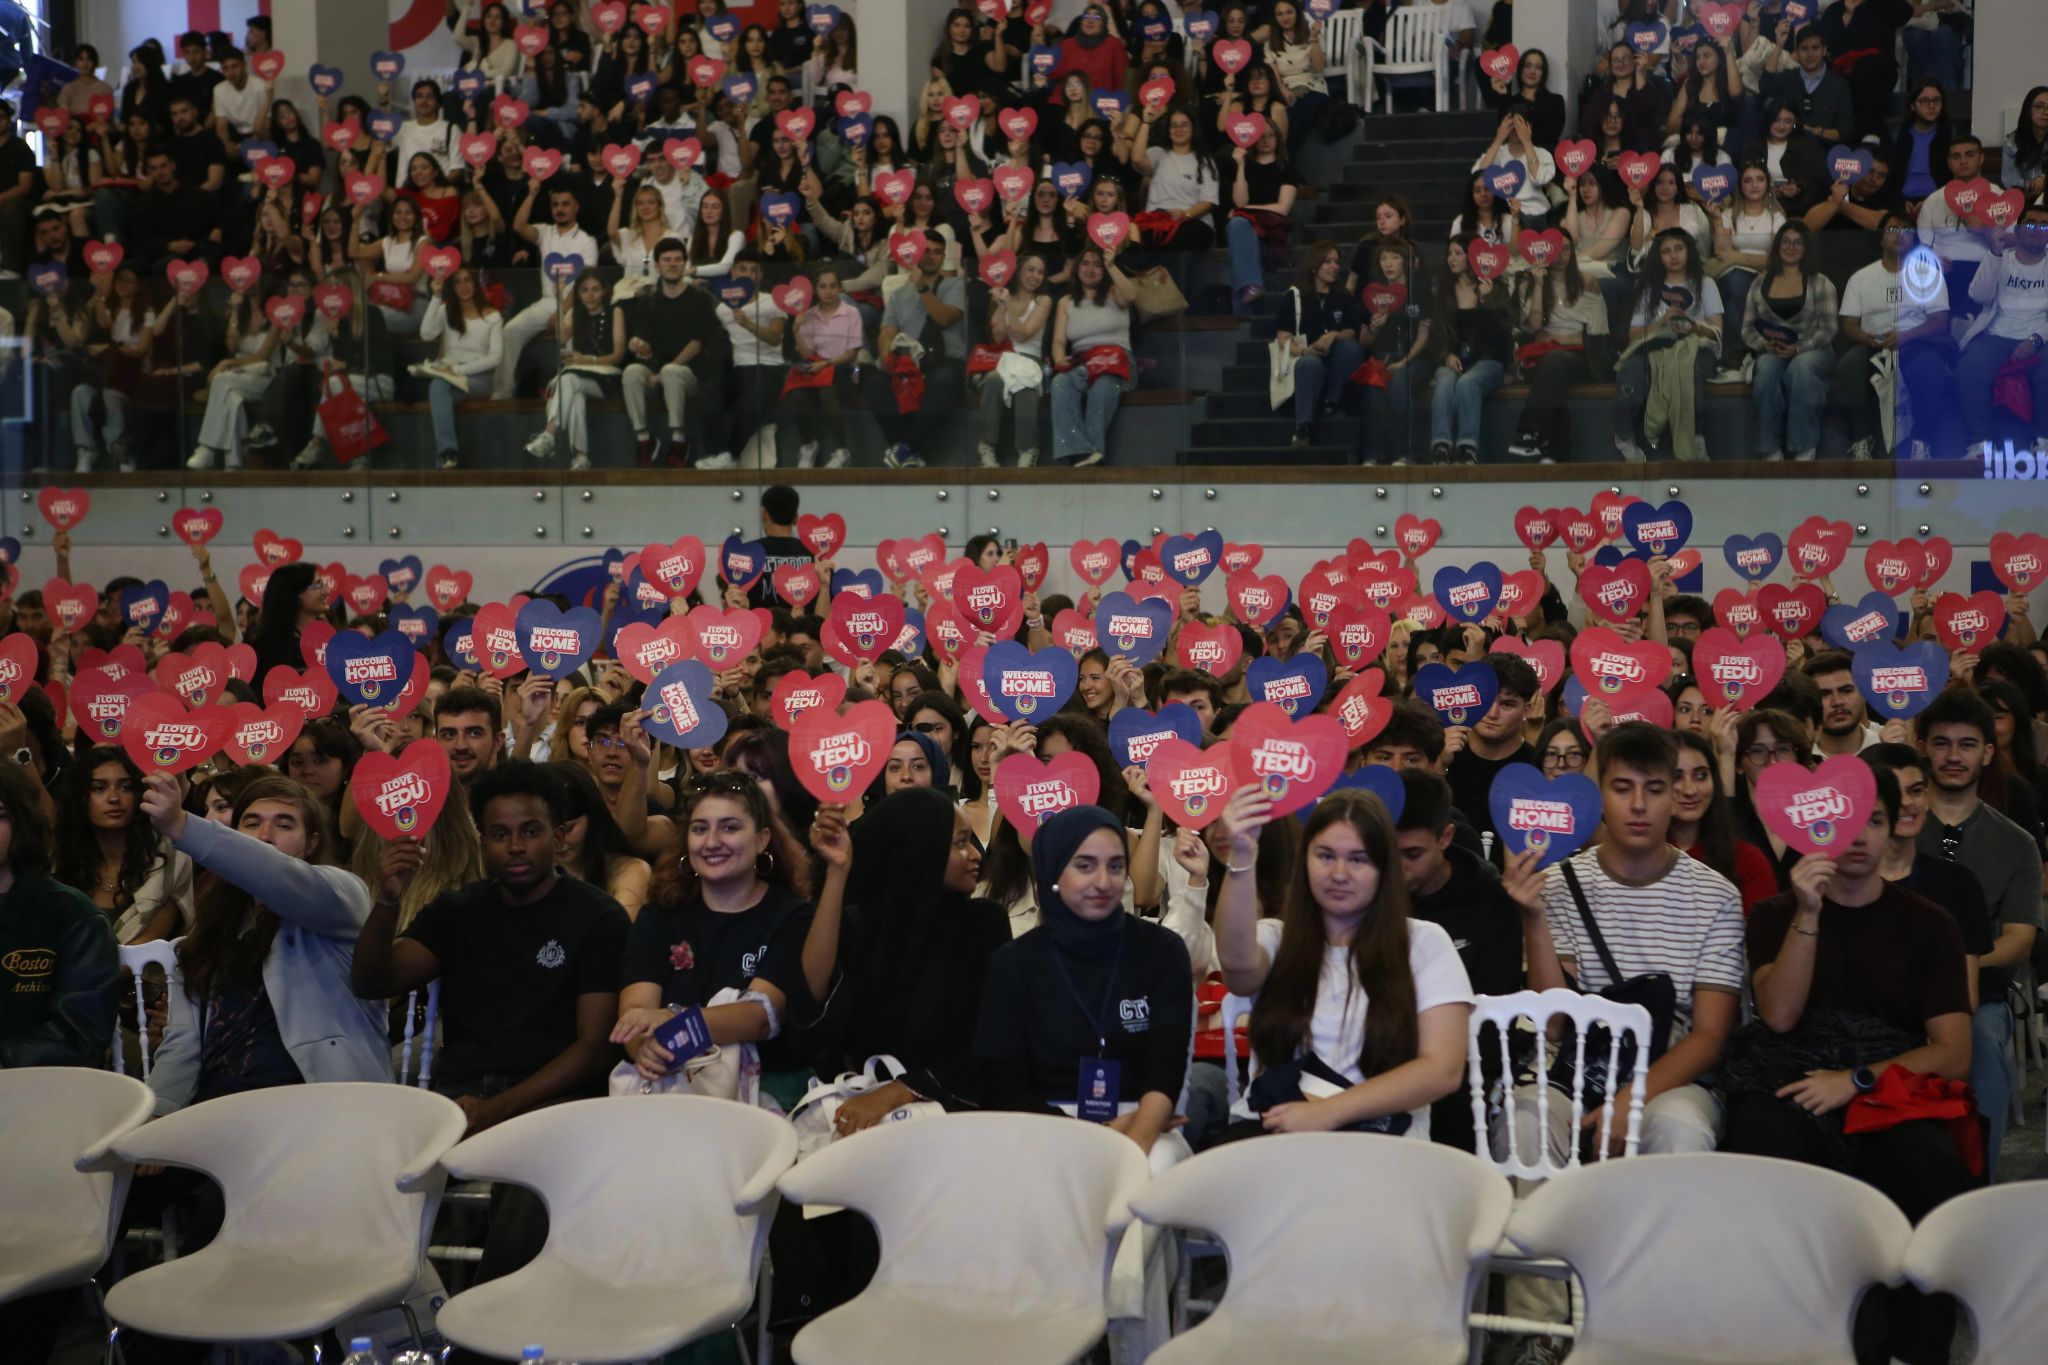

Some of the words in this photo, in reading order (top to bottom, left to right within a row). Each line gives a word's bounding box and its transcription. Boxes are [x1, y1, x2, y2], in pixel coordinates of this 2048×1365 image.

[1525, 525, 1550, 536] TEDU
[1638, 520, 1673, 530] WELCOME
[809, 532, 834, 544] TEDU
[1404, 532, 1427, 544] TEDU
[1568, 527, 1593, 537] TEDU
[1638, 527, 1676, 541] HOME
[1225, 554, 1248, 564] TEDU
[1738, 553, 1769, 566] HOME
[1798, 546, 1827, 562] TEDU
[663, 556, 681, 567] LOVE
[728, 558, 752, 571] HOME
[1082, 556, 1108, 568] TEDU
[1174, 553, 1208, 570] HOME
[2005, 560, 2037, 574] TEDU
[657, 560, 688, 581] TEDU
[1021, 563, 1039, 575] TEDU
[1876, 564, 1907, 577] TEDU
[977, 586, 995, 594] LOVE
[1448, 582, 1482, 595] WELCOME
[1606, 580, 1625, 589] LOVE
[1239, 593, 1268, 605] TEDU
[1365, 587, 1397, 599] TEDU
[1449, 588, 1486, 605] HOME
[1597, 584, 1633, 603] TEDU
[968, 592, 1001, 609] TEDU
[1780, 601, 1800, 609] LOVE
[56, 604, 82, 615] TEDU
[1734, 604, 1751, 612] LOVE
[1771, 607, 1806, 619] TEDU
[1112, 615, 1148, 625] WELCOME
[1726, 611, 1756, 623] TEDU
[1843, 611, 1880, 631] WELCOME
[1957, 611, 1977, 619] LOVE
[711, 626, 732, 634] LOVE
[846, 619, 884, 633] TEDU
[1110, 622, 1148, 635] HOME
[1846, 616, 1888, 640] HOME
[1948, 616, 1984, 633] TEDU
[499, 629, 515, 638] LOV
[532, 627, 576, 638] WELCOME
[700, 632, 738, 645] TEDU
[1339, 630, 1370, 644] TEDU
[530, 634, 576, 651] HOME
[646, 639, 667, 651] LOVE
[1066, 632, 1096, 648] TEDU
[1198, 641, 1215, 649] LOVE
[345, 656, 389, 667] WELCOME
[636, 644, 675, 666] TEDU
[1188, 648, 1220, 662] TEDU
[1606, 654, 1635, 664] LOVE
[1724, 656, 1751, 665] LOVE
[184, 667, 203, 680] LOVE
[345, 664, 393, 680] HOME
[1590, 657, 1640, 678] TEDU
[1711, 664, 1757, 680] TEDU
[1872, 666, 1920, 675] WELCOME
[176, 671, 210, 694] TEDU
[1003, 671, 1049, 681] WELCOME
[1264, 676, 1303, 688] WELCOME
[1872, 674, 1922, 690] HOME
[288, 688, 309, 696] LOVE
[797, 689, 817, 697] LOVE
[1003, 680, 1051, 693] HOME
[1264, 681, 1307, 702] HOME
[1433, 684, 1473, 696] WELCOME
[101, 695, 125, 703] LOVE
[677, 681, 699, 722] WELCOME
[784, 695, 821, 709] TEDU
[1433, 694, 1478, 710] HOME
[663, 684, 692, 730] HOME
[165, 725, 195, 734] LOVE
[248, 721, 273, 732] LOVE
[146, 732, 201, 748] TEDU
[237, 727, 279, 744] TEDU
[825, 733, 854, 747] LOVE
[1129, 731, 1172, 745] WELCOME
[1269, 740, 1302, 757] LOVE
[811, 743, 865, 771] TEDU
[1252, 750, 1310, 775] TEDU
[1184, 768, 1212, 779] LOVE
[387, 773, 413, 791] LOVE
[1032, 781, 1061, 793] LOVE
[1170, 775, 1220, 797] TEDU
[376, 780, 424, 815] TEDU
[1019, 789, 1070, 813] TEDU
[1798, 788, 1831, 802] LOVE
[1511, 799, 1568, 812] WELCOME
[1786, 796, 1844, 824] TEDU
[1511, 808, 1570, 829] HOME
